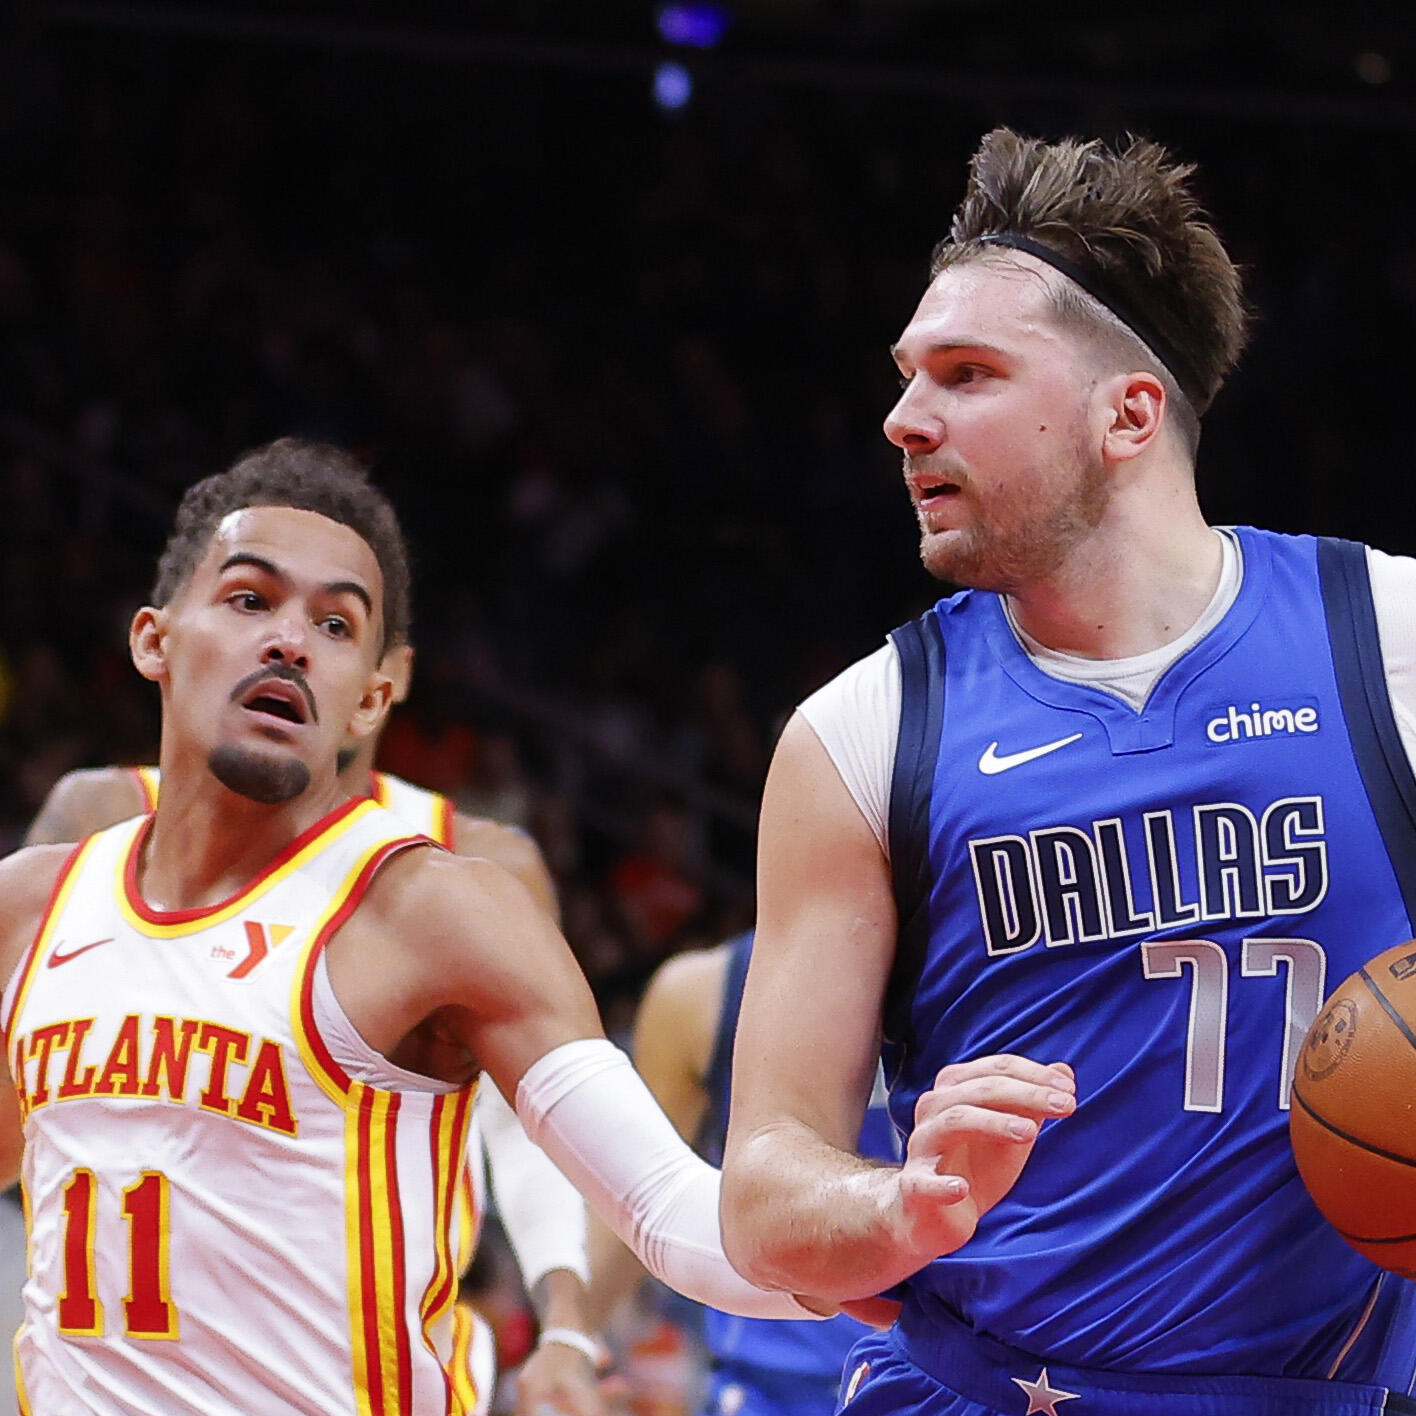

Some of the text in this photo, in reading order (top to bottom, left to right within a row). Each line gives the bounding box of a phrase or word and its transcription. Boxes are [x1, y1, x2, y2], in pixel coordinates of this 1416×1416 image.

[1206, 702, 1319, 743] chime
[968, 796, 1330, 957] DALLAS
[57, 1166, 181, 1341] 11
